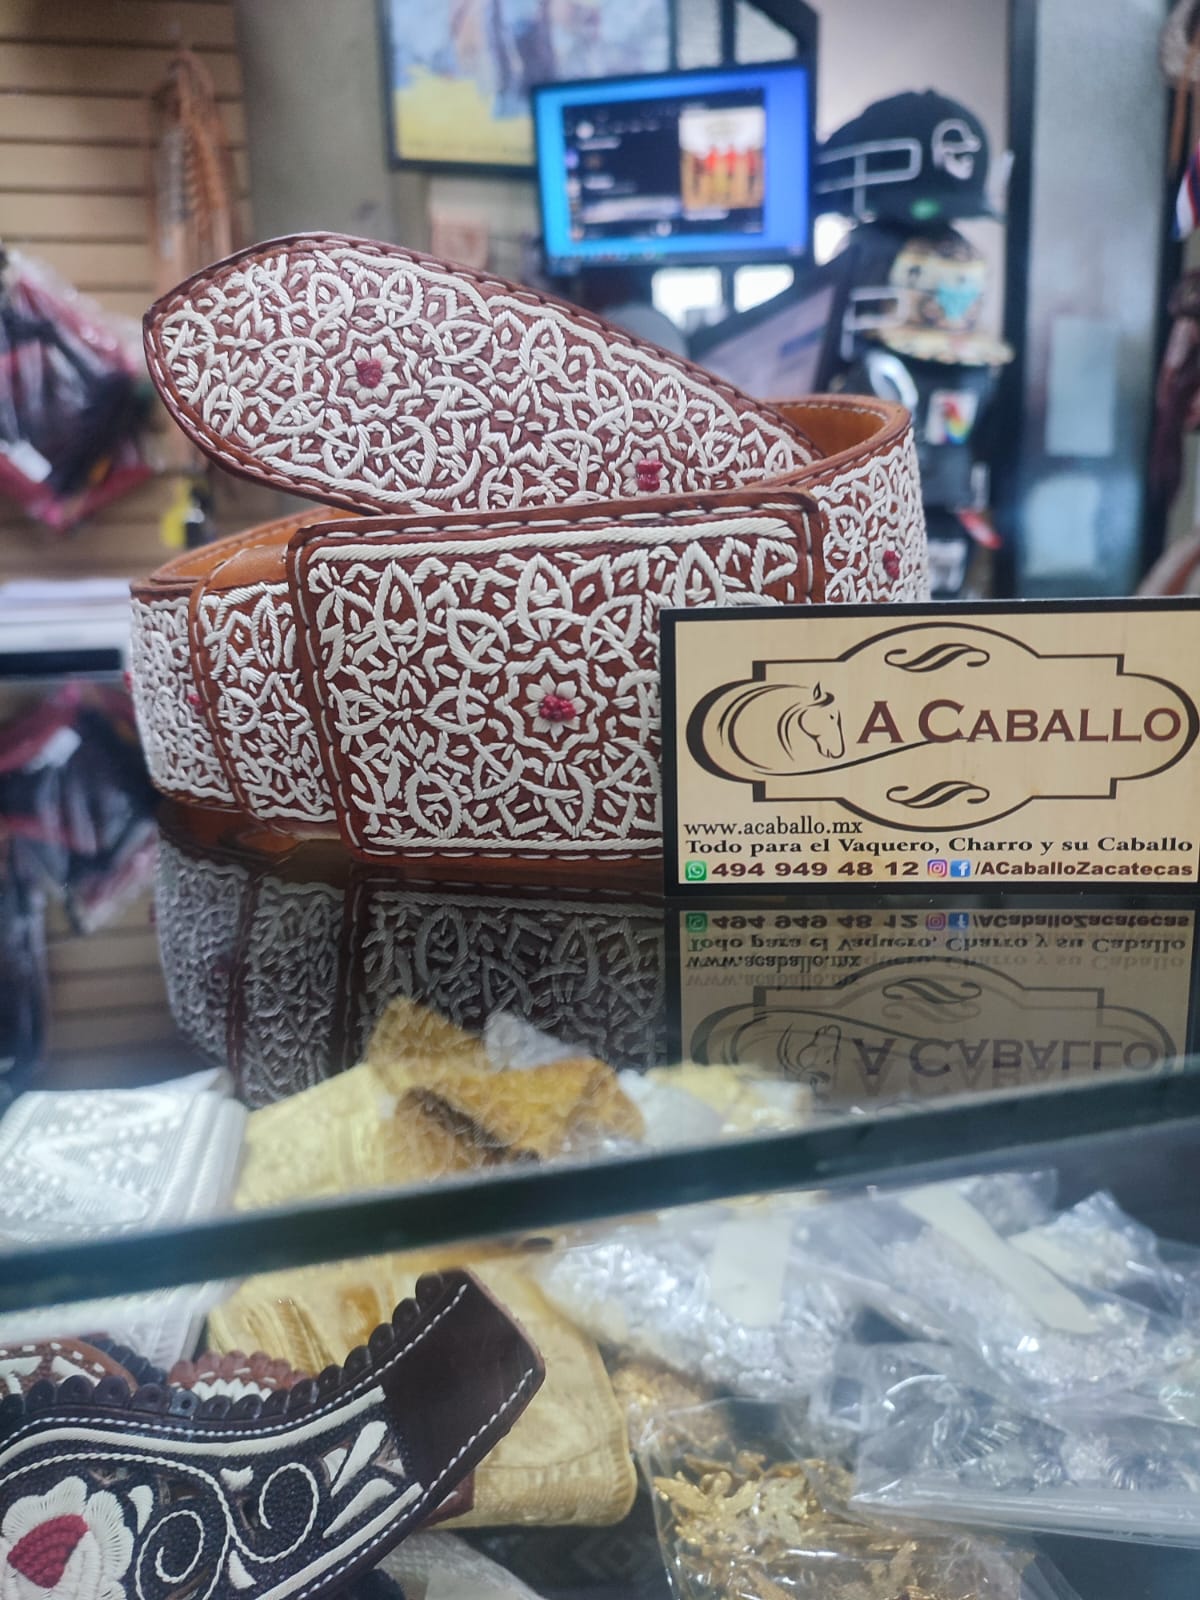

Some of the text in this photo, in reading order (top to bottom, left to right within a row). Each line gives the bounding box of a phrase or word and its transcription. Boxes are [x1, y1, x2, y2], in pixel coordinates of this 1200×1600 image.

[857, 699, 1181, 743] A CABALLO
[684, 816, 863, 834] www.acaballo.mx
[686, 837, 1193, 857] Todo para el Vaquero, Charro y su Caballo
[711, 861, 1193, 876] 494 949 48 12 /ACaballoZacatecas
